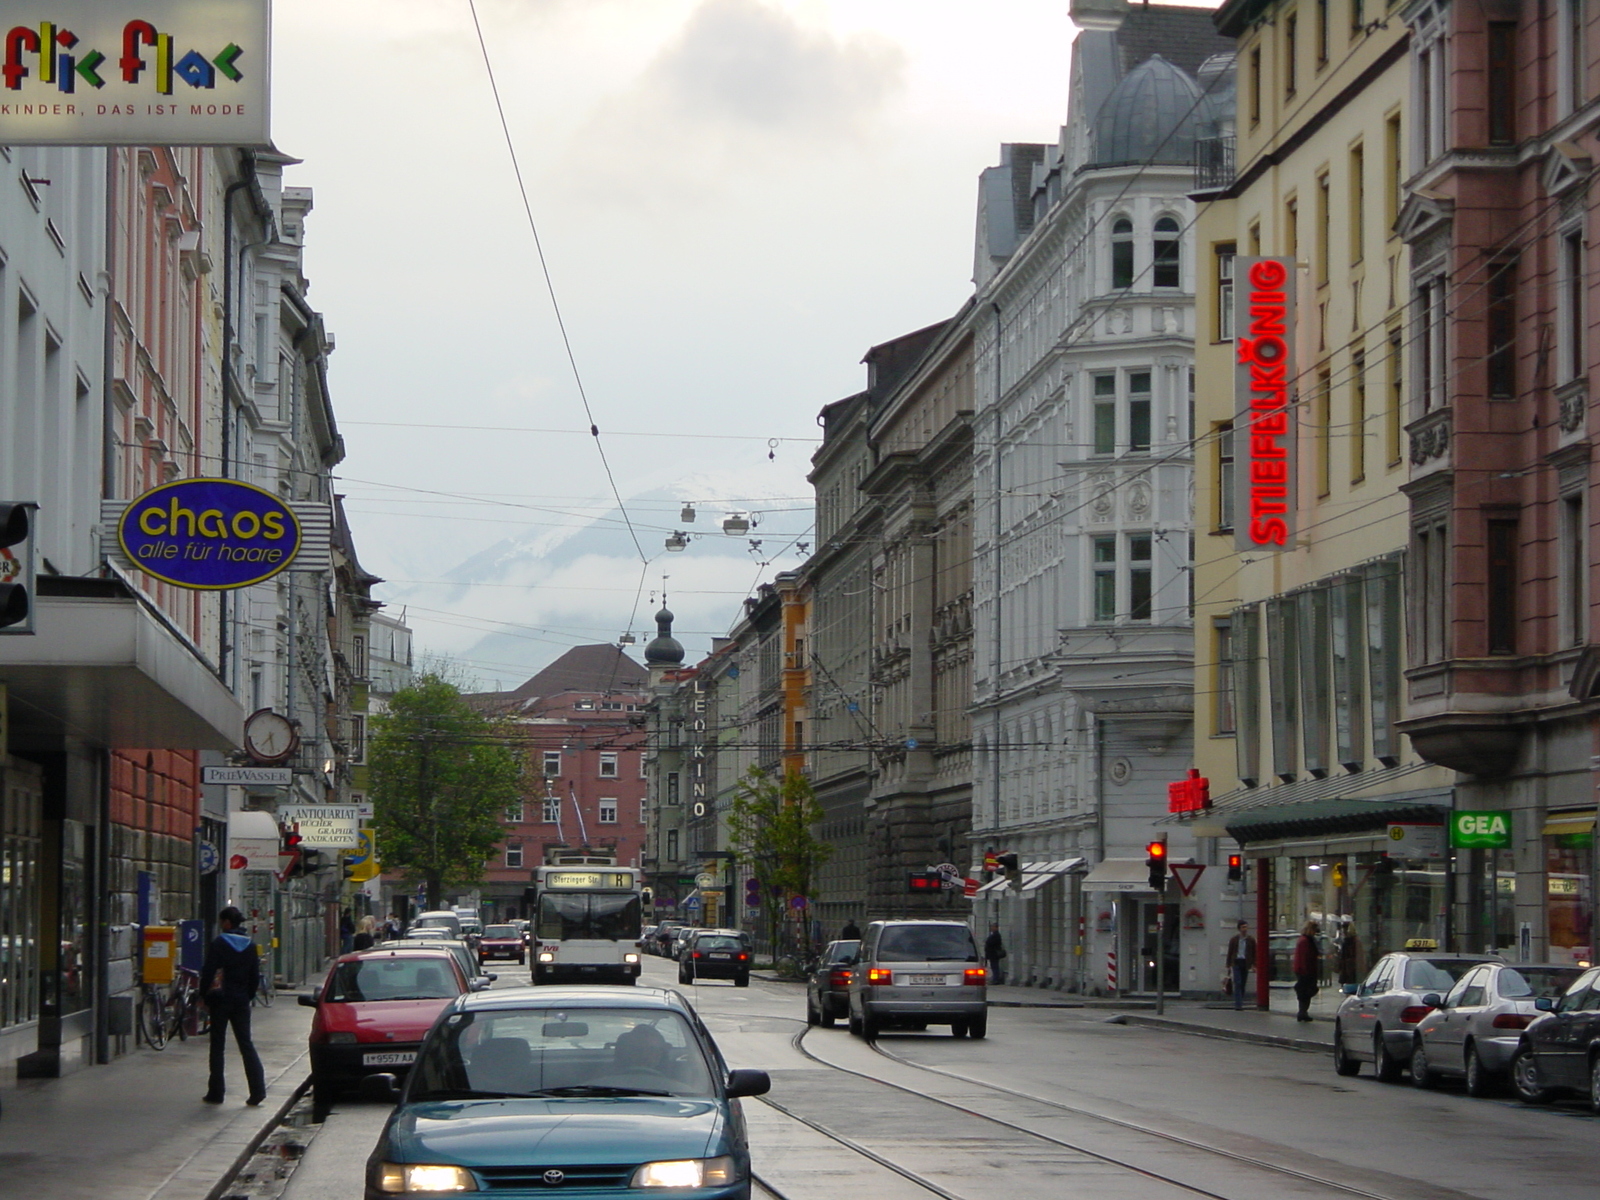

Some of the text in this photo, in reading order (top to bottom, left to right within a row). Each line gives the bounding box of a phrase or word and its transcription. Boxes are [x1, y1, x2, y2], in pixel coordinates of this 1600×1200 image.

[2, 19, 244, 95] flic flac
[1, 104, 246, 117] KINDER, DAS IST MODE
[139, 496, 285, 540] chaos
[138, 541, 283, 563] alle für haare
[694, 680, 706, 817] LEO KINO
[296, 808, 356, 821] ANTIQUARIAT
[1458, 815, 1507, 835] GEA
[553, 875, 586, 885] Sterzinger
[615, 874, 623, 887] R
[377, 1053, 399, 1064] 9557
[401, 1053, 414, 1063] AA
